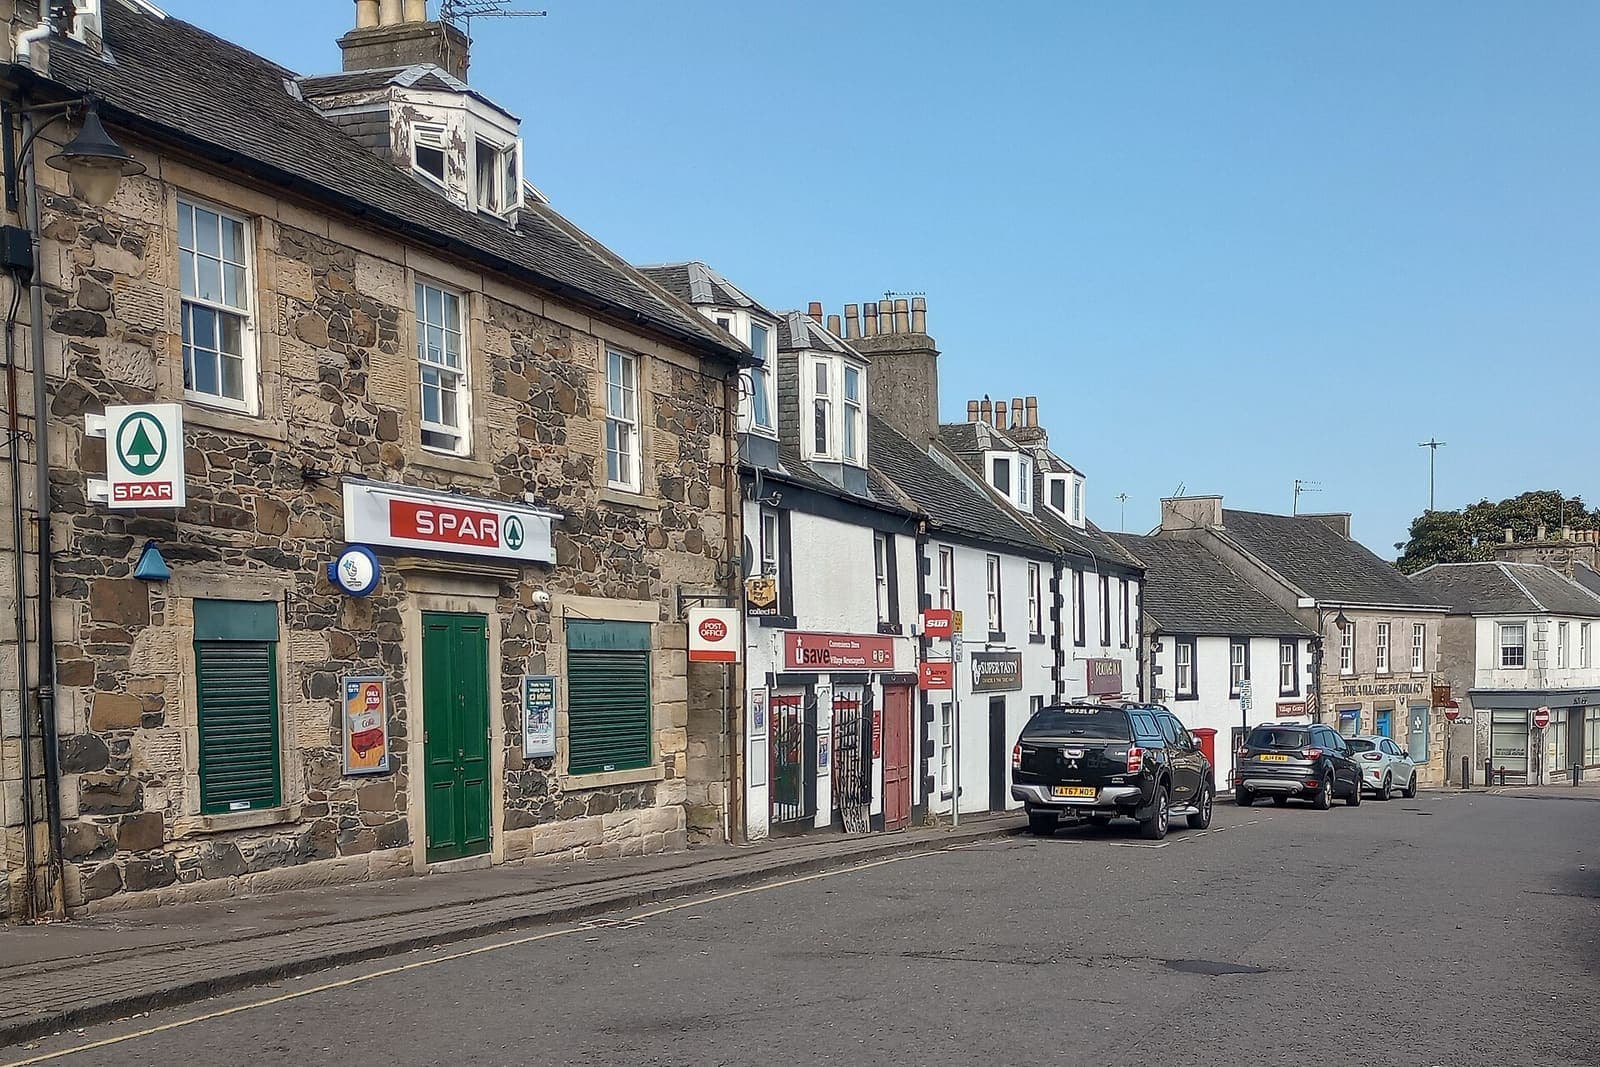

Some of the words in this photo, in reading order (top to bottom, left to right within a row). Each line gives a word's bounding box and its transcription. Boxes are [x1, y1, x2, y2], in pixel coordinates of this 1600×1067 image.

[115, 485, 171, 499] SPAR
[415, 510, 497, 542] SPAR
[704, 622, 721, 631] POST
[701, 629, 724, 638] OFFICE
[980, 661, 999, 674] SUPER
[1000, 660, 1018, 674] TASTY
[1342, 685, 1357, 696] THE
